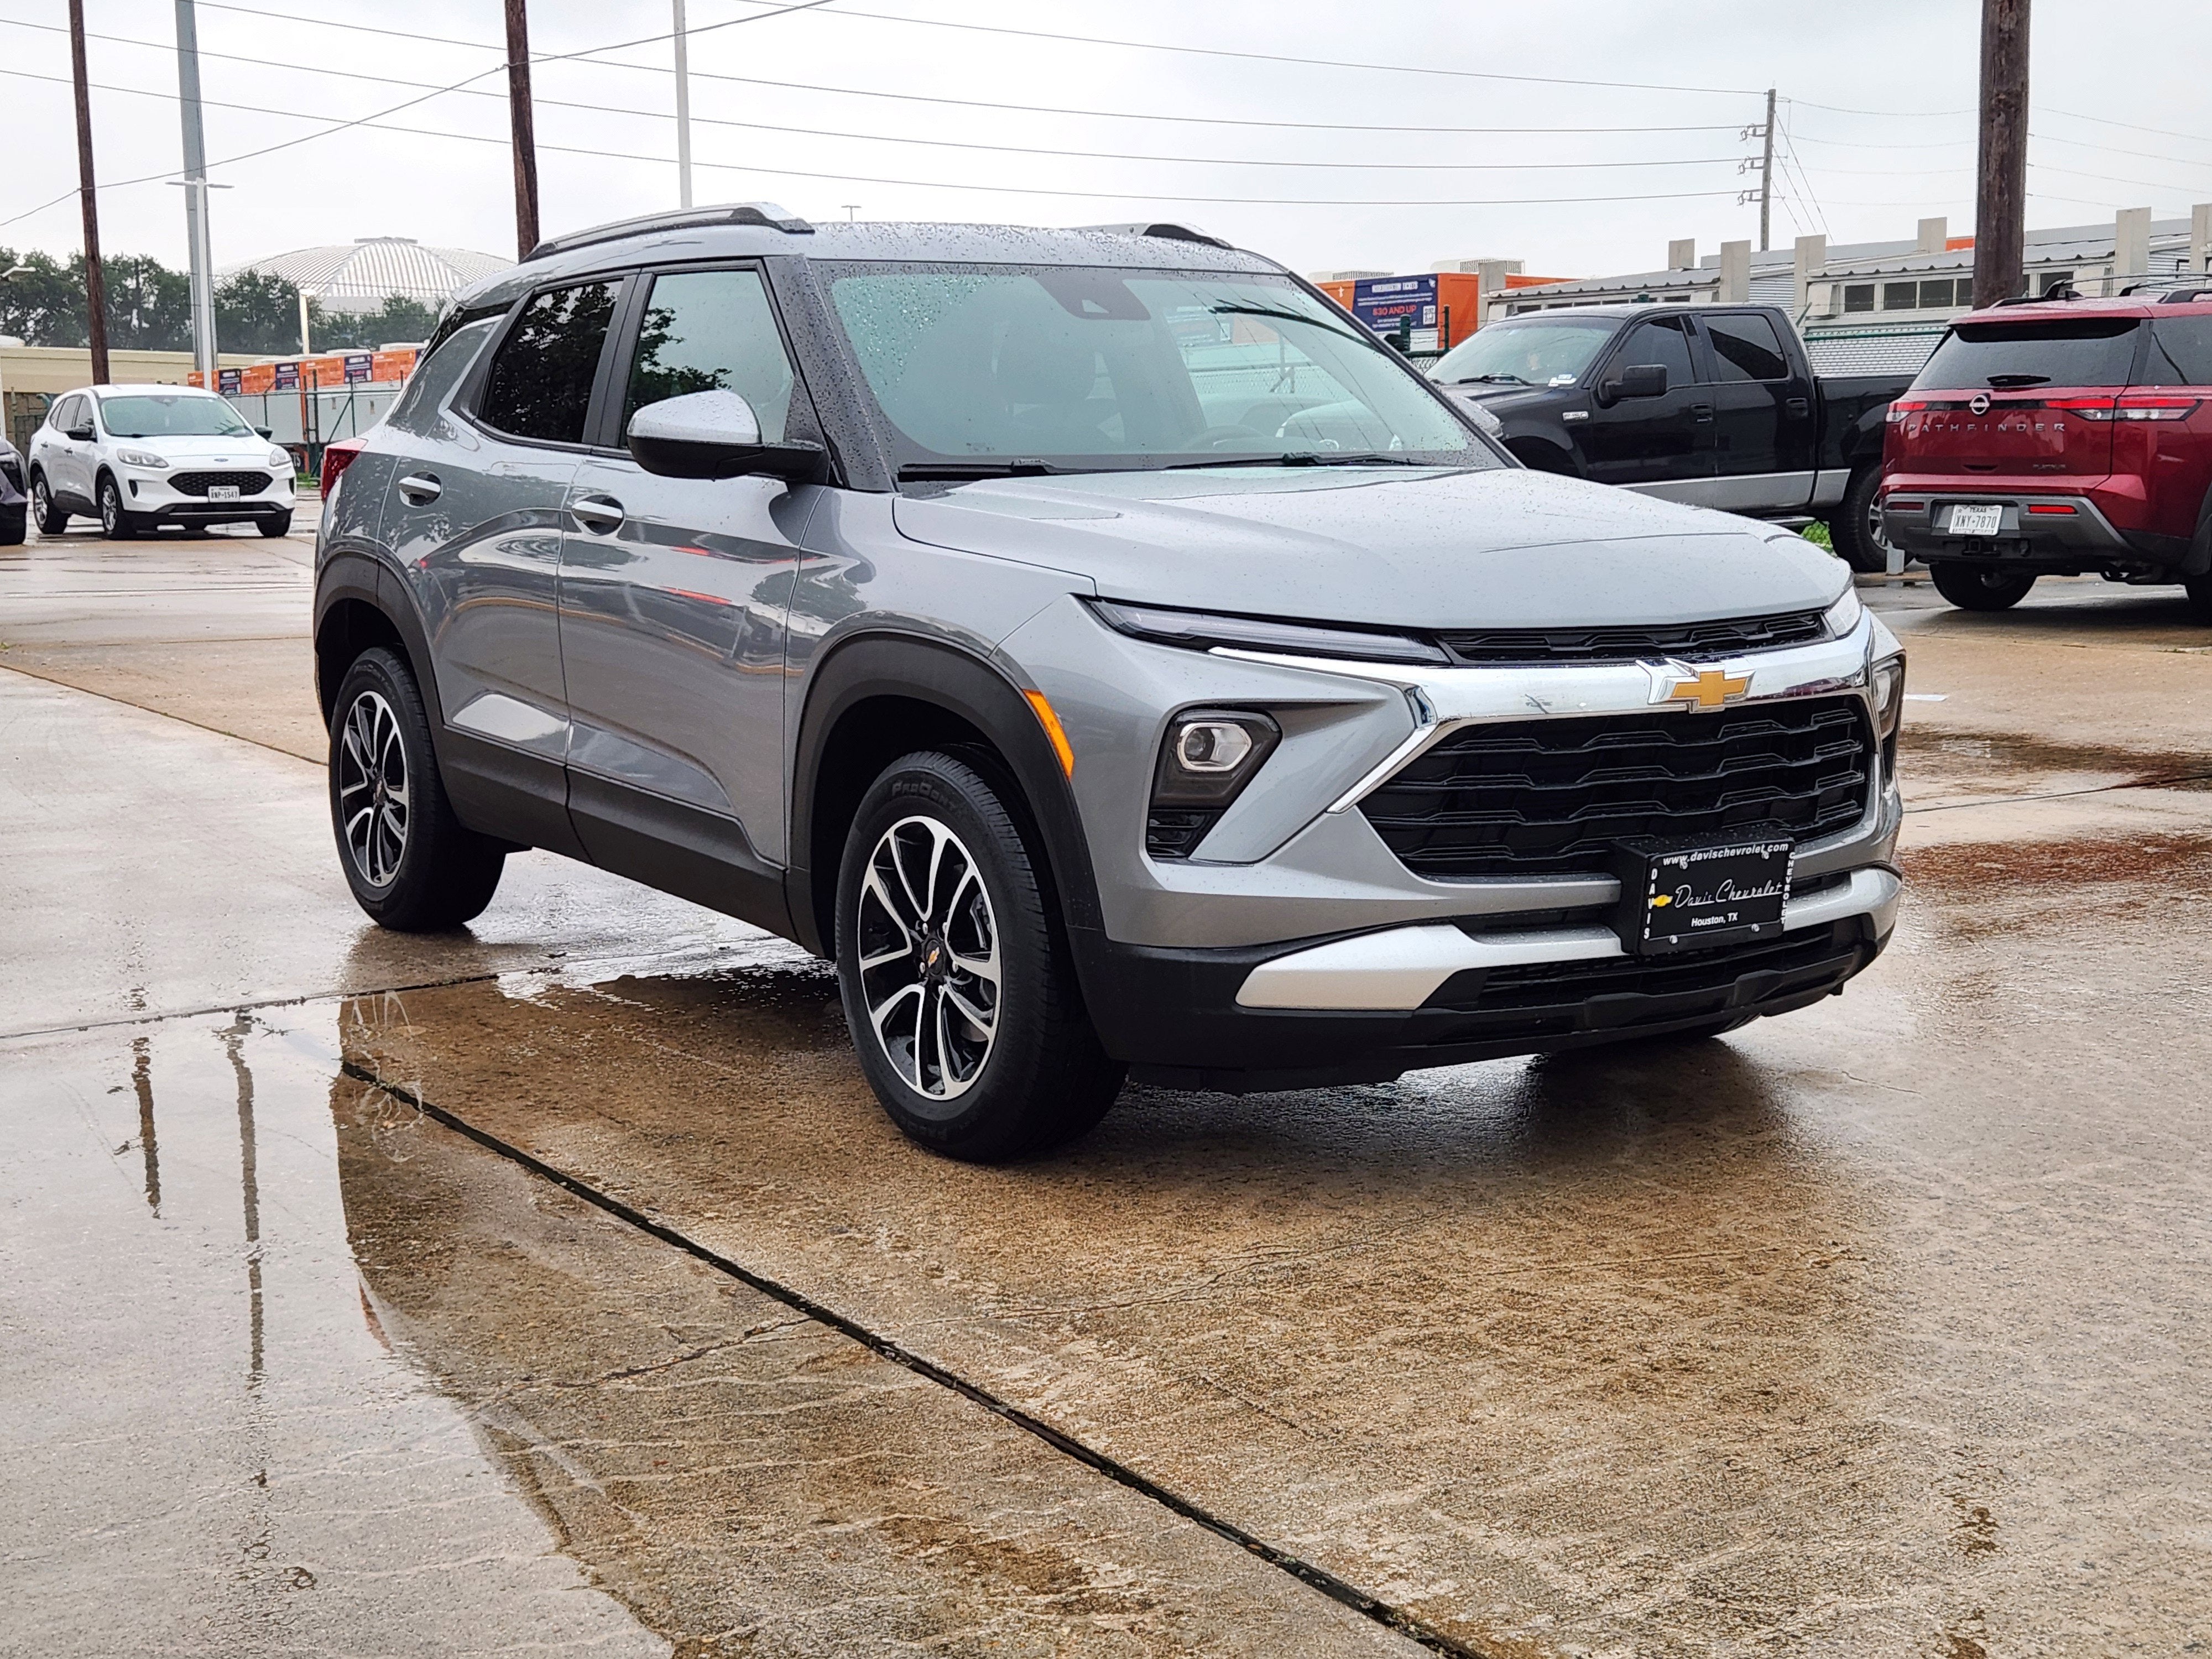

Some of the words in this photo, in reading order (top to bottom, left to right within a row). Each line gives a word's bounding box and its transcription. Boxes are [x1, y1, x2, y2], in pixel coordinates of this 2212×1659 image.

[1389, 305, 1405, 315] AND
[1406, 305, 1417, 314] UP
[1907, 423, 2065, 432] PATHFINDER
[1663, 843, 1789, 866] www.davischevrolet.com
[1674, 885, 1715, 909] Davis
[1715, 879, 1783, 903] Chevrolet
[1780, 852, 1796, 925] CHEVROLET
[1644, 868, 1658, 940] DAVIS
[1691, 916, 1726, 927] Houston,
[1728, 911, 1739, 921] TX
